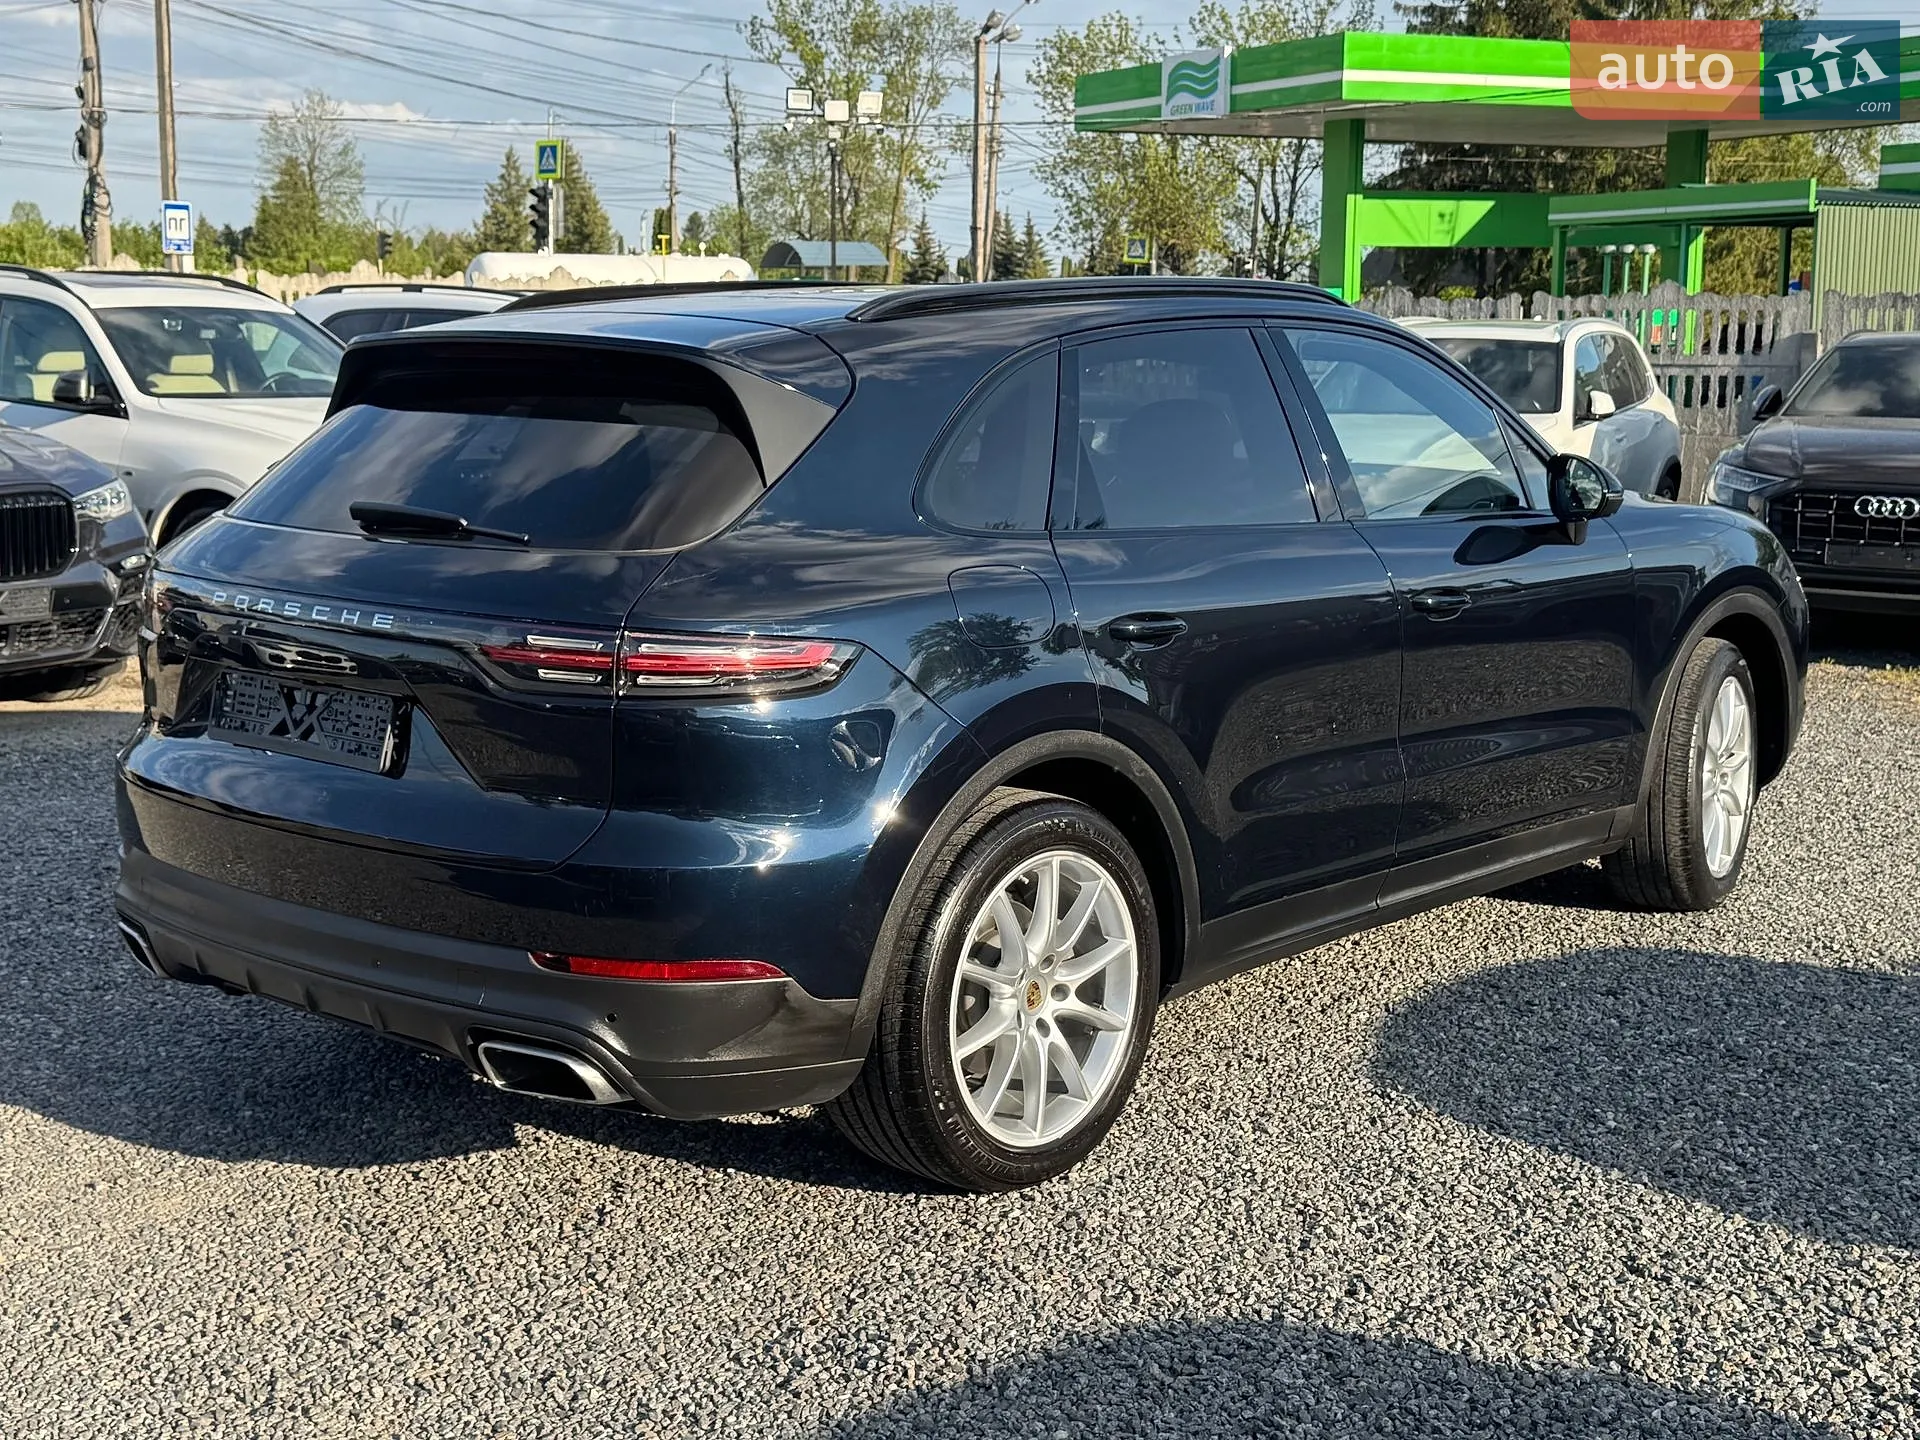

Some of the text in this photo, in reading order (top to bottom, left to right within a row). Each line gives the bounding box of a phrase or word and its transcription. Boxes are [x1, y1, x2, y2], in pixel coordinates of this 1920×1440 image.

[1170, 99, 1216, 116] GREEN WAVE
[213, 591, 395, 629] PORSCHE
